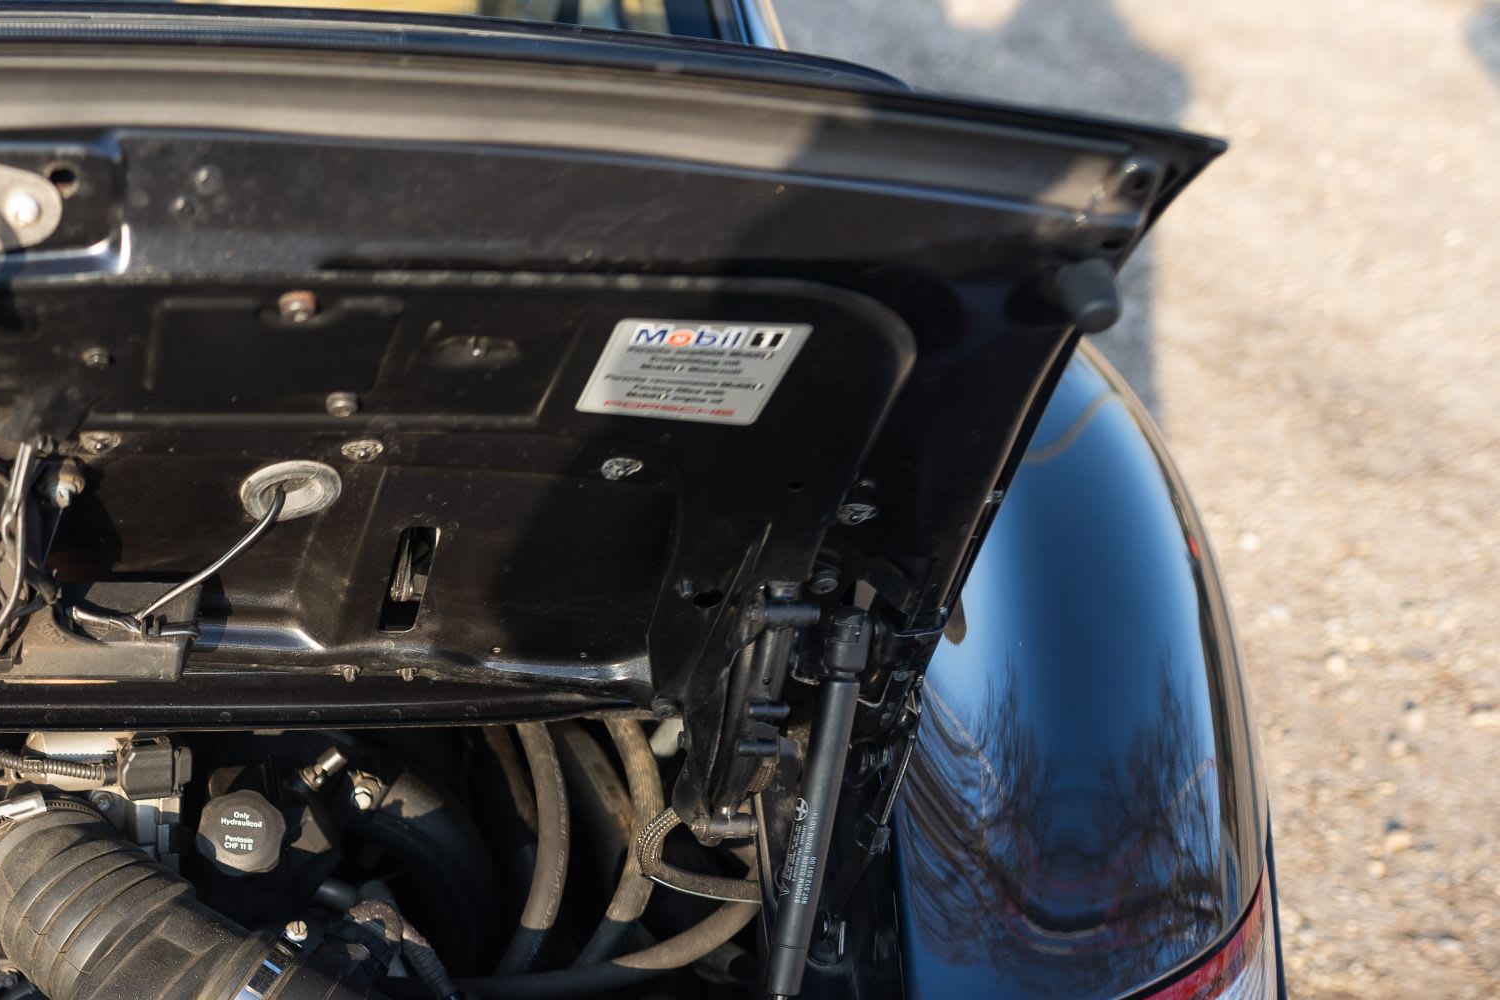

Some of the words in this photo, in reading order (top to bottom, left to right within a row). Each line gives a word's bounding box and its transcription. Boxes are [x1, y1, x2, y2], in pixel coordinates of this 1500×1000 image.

[635, 329, 742, 347] Mobil
[604, 400, 735, 416] PORSCHE
[233, 811, 250, 820] Only
[220, 817, 262, 828] Hydraulicoil
[224, 834, 253, 844] Pentosin
[223, 841, 239, 849] CHF
